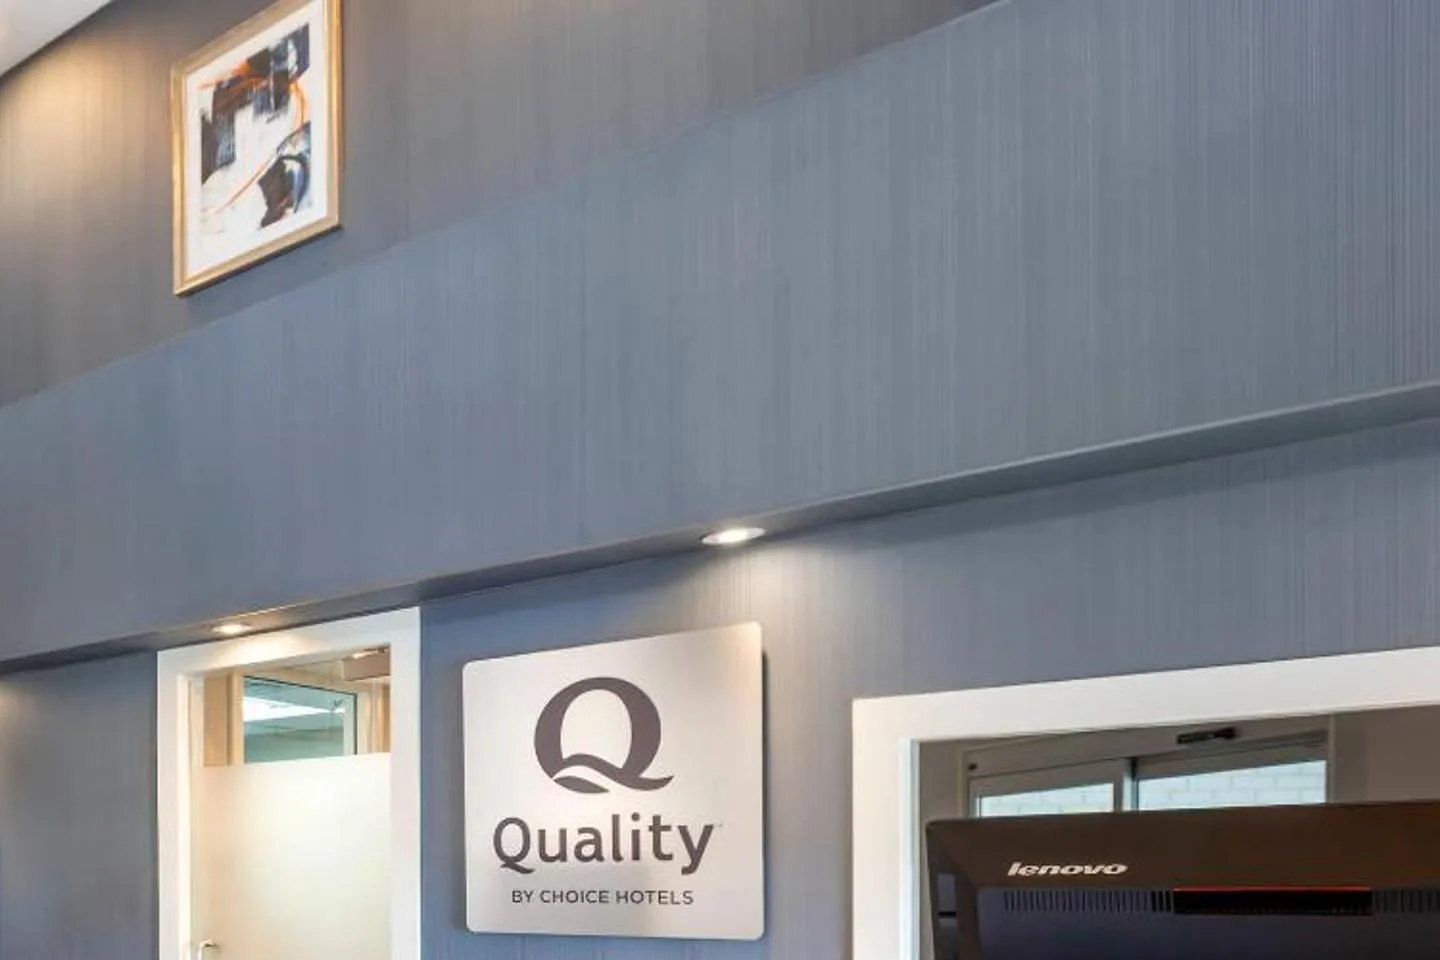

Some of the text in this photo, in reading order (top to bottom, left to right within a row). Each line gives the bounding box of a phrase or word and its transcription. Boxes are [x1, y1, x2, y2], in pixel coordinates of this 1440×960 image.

[534, 676, 674, 794] Q
[493, 812, 714, 875] Quality
[1007, 861, 1128, 876] lenovo
[511, 889, 694, 905] BY CHOICE HOTELS
